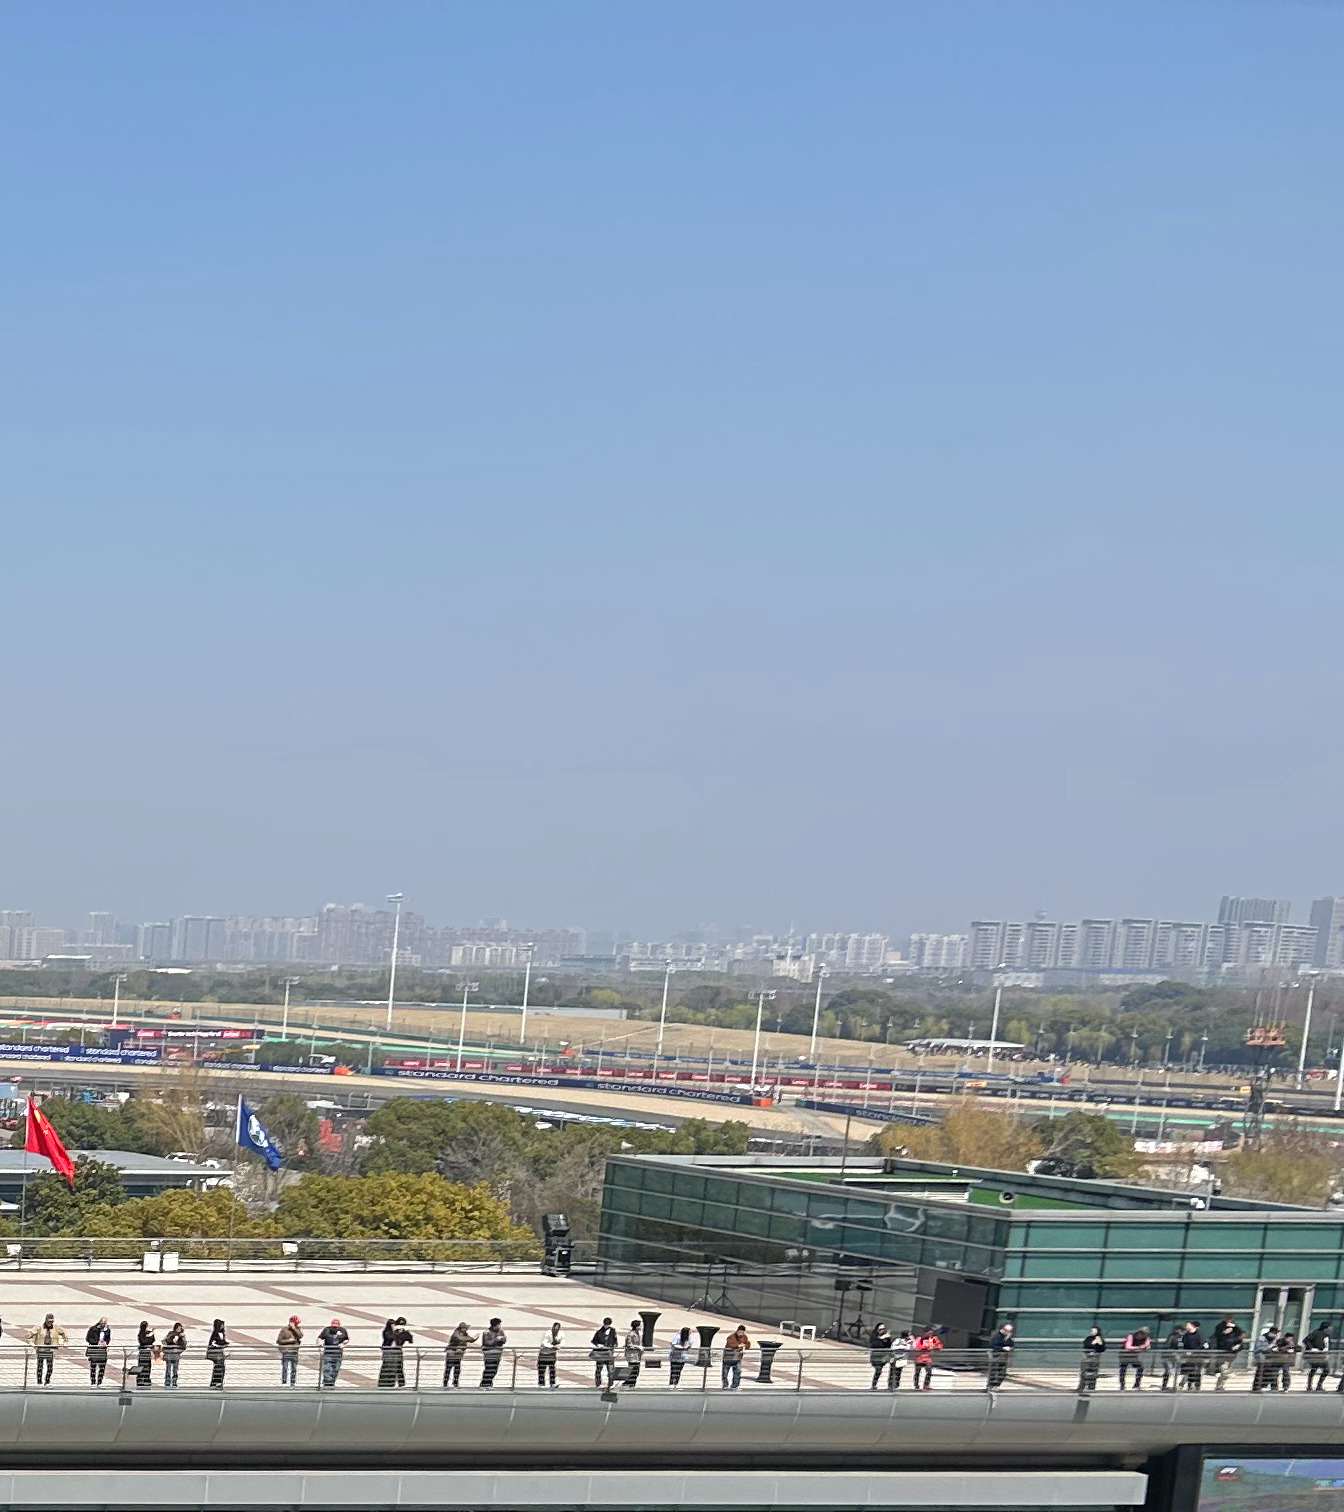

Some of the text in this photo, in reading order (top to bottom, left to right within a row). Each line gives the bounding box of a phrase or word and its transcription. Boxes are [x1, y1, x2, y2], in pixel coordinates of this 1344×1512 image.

[121, 1048, 156, 1057] chartered
[397, 1069, 476, 1081] standard
[478, 1073, 558, 1087] chartered
[597, 1082, 741, 1104] standard chartered
